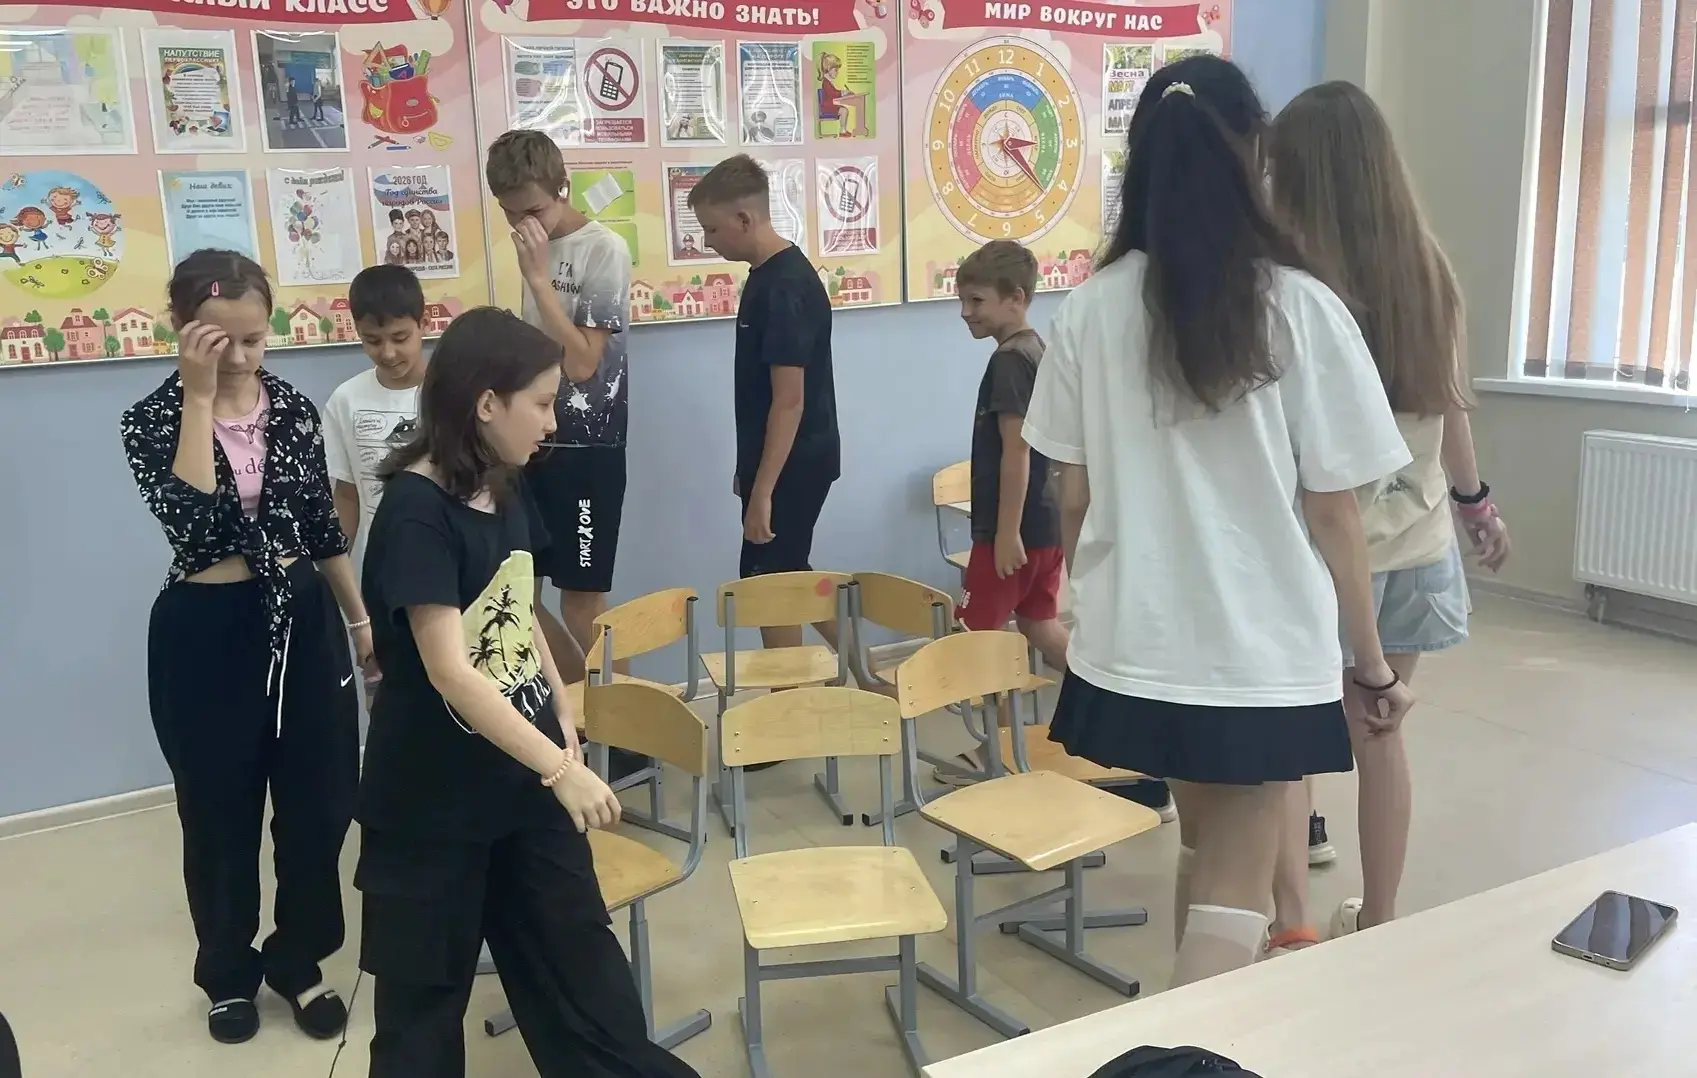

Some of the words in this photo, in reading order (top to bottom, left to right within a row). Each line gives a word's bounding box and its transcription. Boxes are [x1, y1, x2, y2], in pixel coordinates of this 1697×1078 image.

[631, 0, 725, 20] ВАЖНО
[735, 4, 819, 26] ЗНАТЬ!
[985, 2, 1032, 20] МИР
[1040, 6, 1117, 29] ВОКРУГ
[1124, 14, 1163, 31] НАС
[163, 49, 221, 58] НАПУТСТВИЕ
[998, 48, 1014, 65] 12
[965, 58, 981, 77] 11
[1036, 62, 1045, 77] 1
[939, 88, 956, 112] 10
[1058, 94, 1070, 109] 2
[932, 139, 945, 151] 9
[1066, 137, 1078, 149] 3
[392, 175, 411, 185] 2026
[412, 175, 428, 185] ГОД
[1057, 179, 1068, 192] 4
[385, 189, 399, 198] Год
[941, 181, 955, 195] 8
[967, 212, 978, 228] 7
[1035, 209, 1046, 225] 5
[1002, 221, 1012, 237] 6
